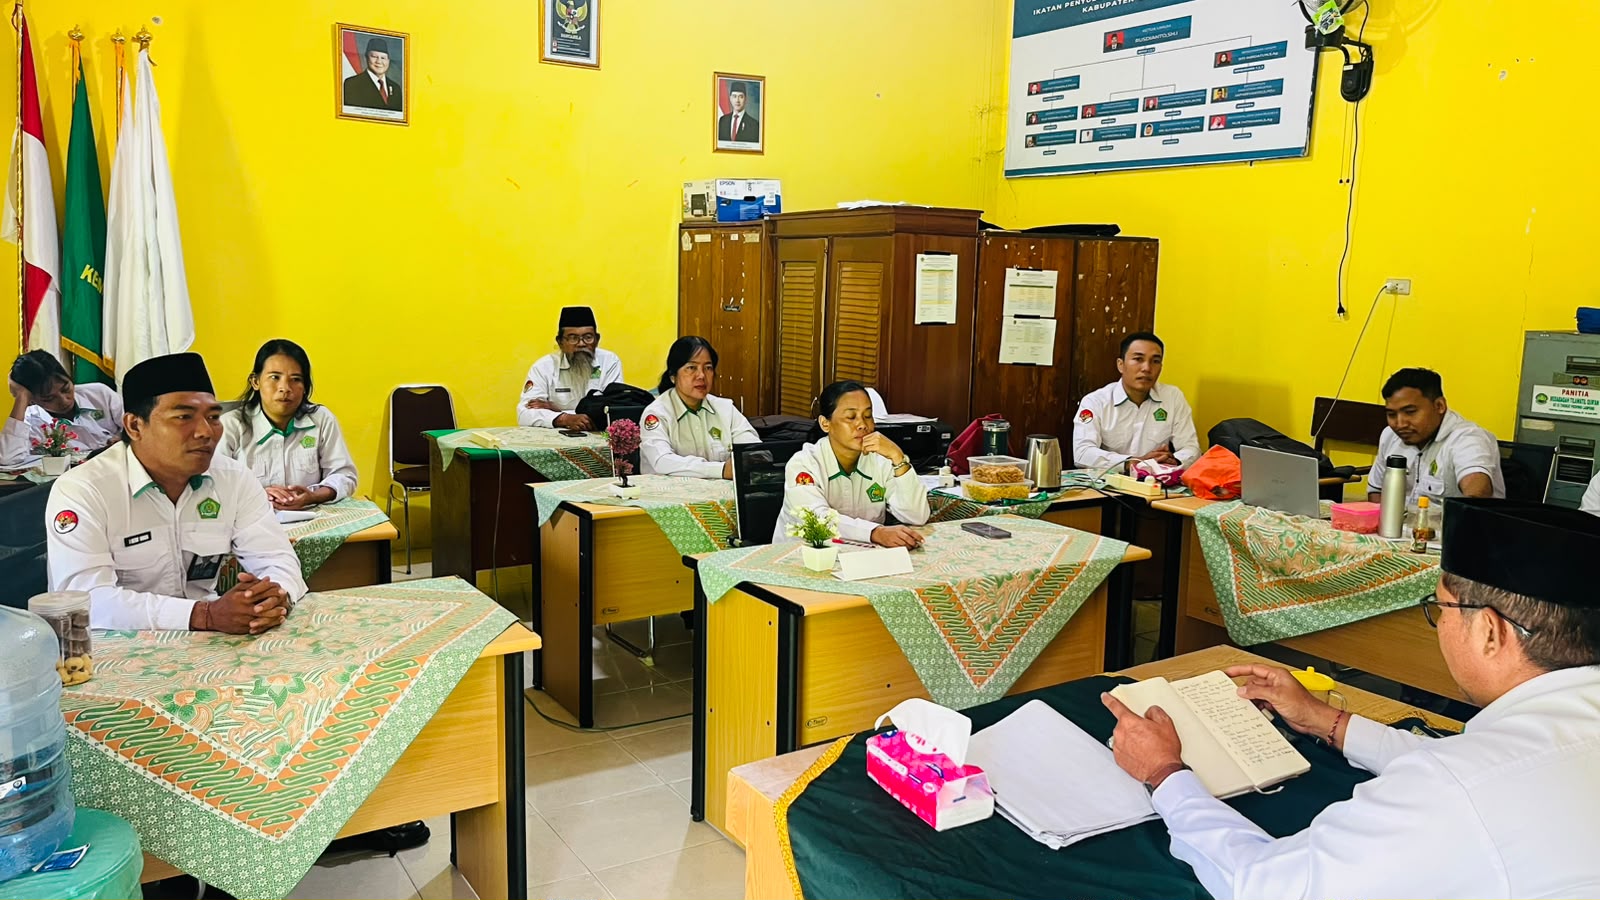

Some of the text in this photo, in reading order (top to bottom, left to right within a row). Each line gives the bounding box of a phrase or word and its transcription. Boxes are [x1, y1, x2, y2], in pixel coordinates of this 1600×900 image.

[1033, 0, 1097, 15] IKATAN PENYU
[1561, 389, 1589, 397] PANITIA
